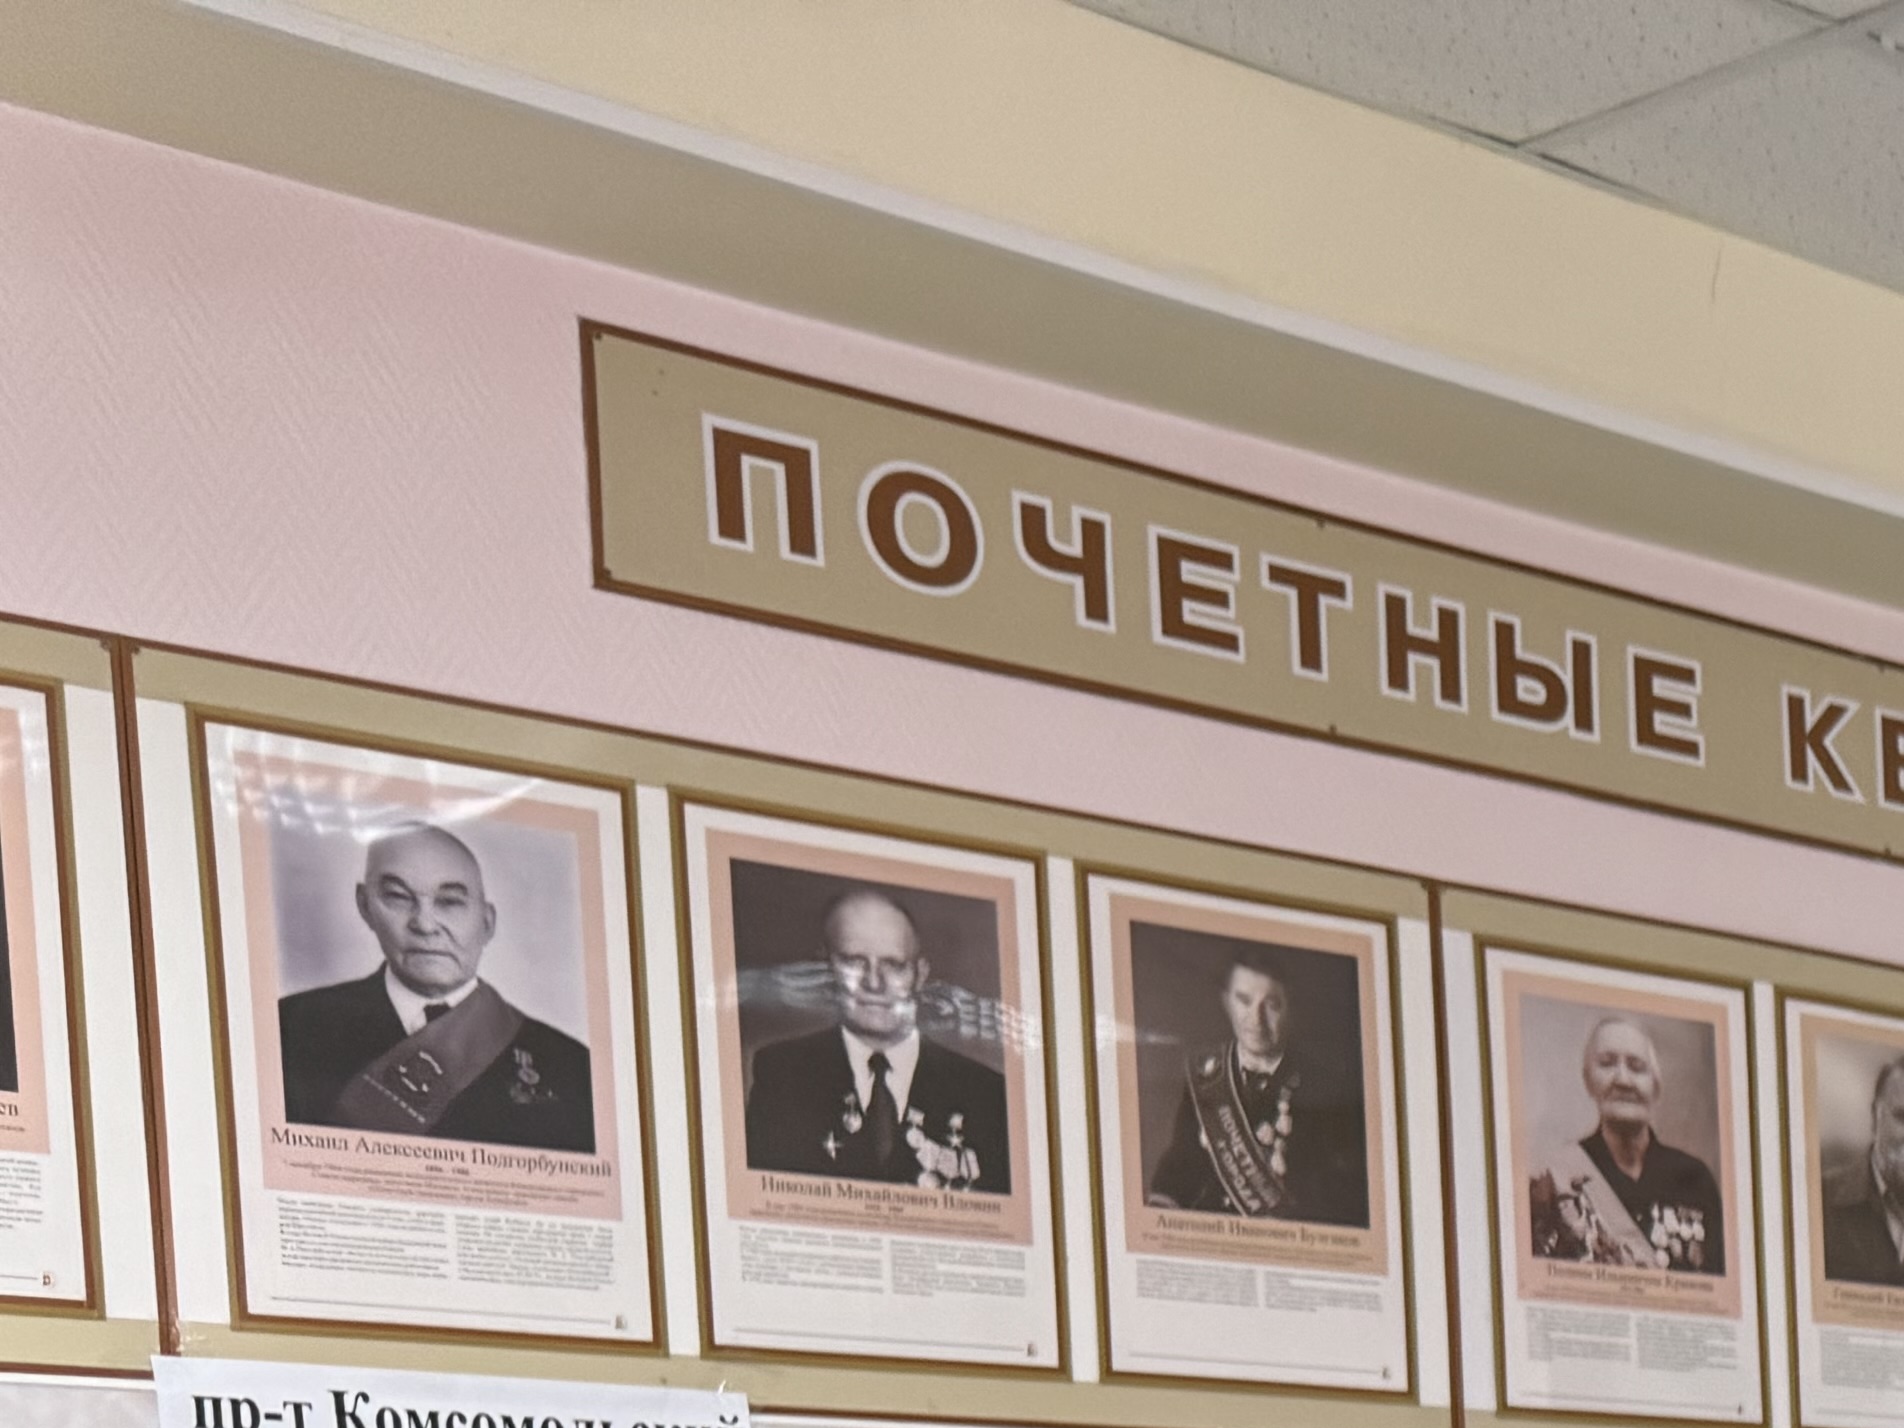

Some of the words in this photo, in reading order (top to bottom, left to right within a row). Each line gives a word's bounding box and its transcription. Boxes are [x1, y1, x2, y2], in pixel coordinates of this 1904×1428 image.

[702, 412, 1704, 766] ПОЧЕТНЫЕ
[271, 1126, 348, 1152] Михаил
[354, 1137, 466, 1166] Алексеевич
[470, 1149, 613, 1178] Подгорбунский
